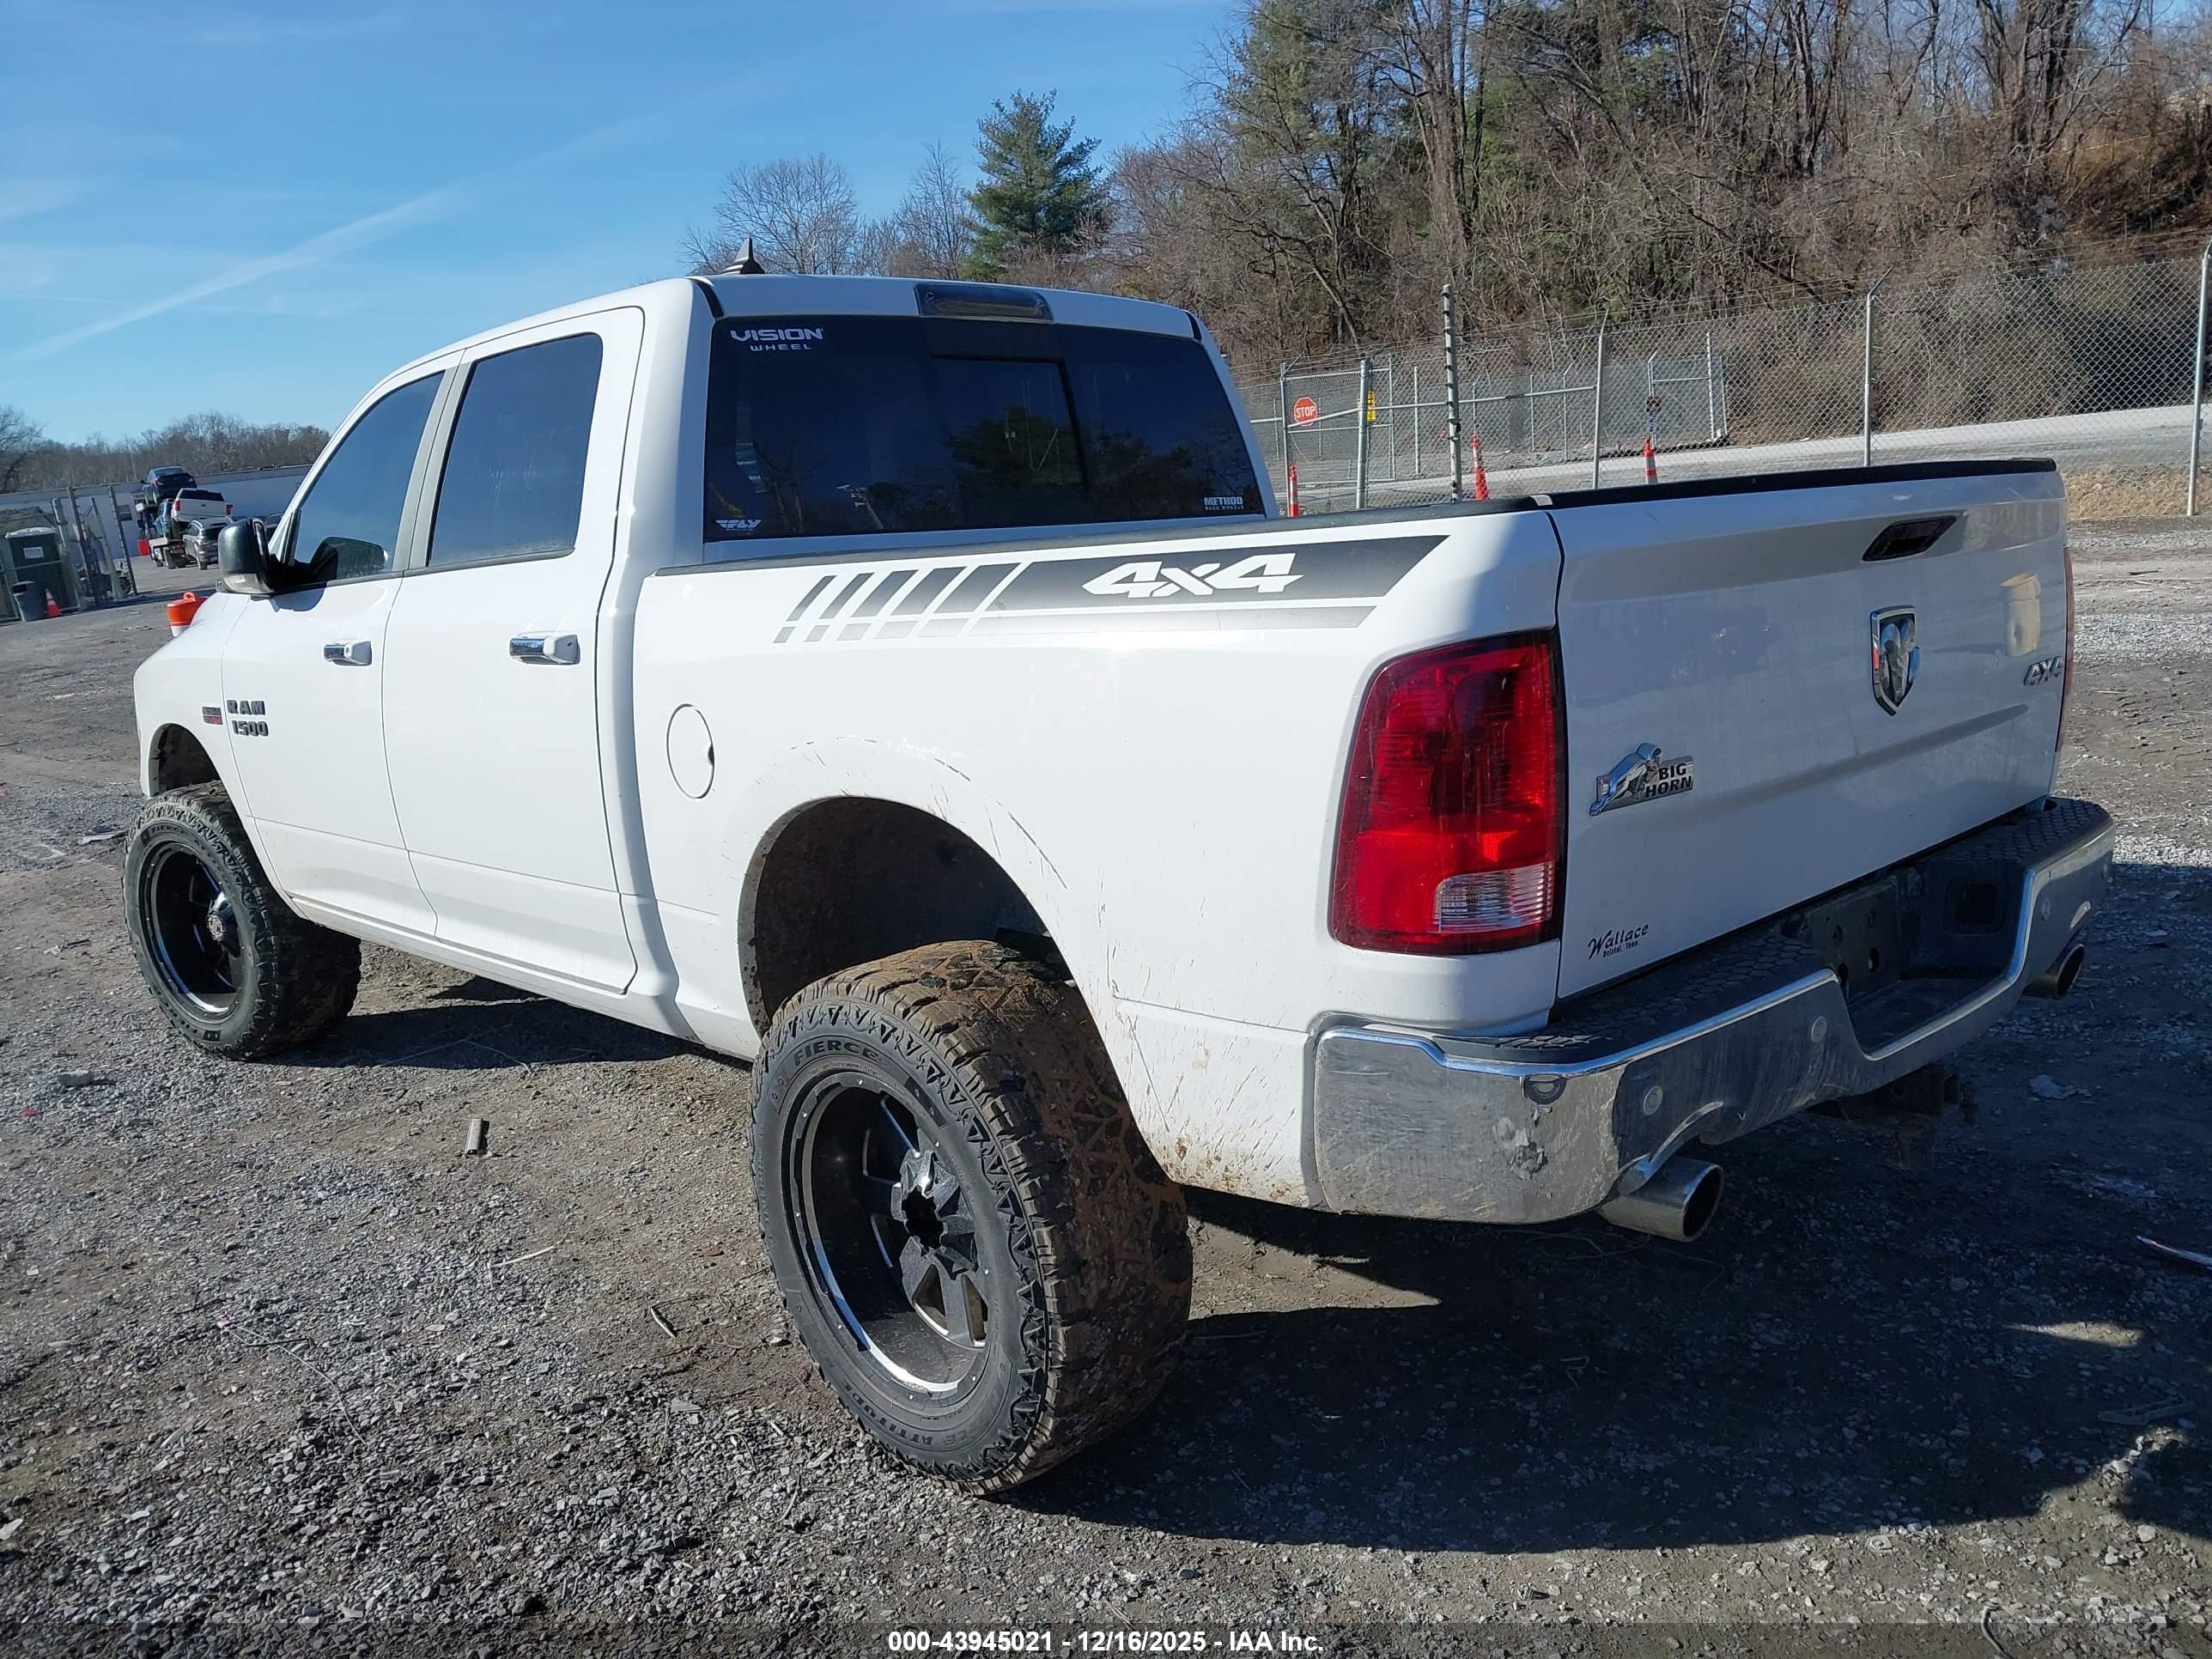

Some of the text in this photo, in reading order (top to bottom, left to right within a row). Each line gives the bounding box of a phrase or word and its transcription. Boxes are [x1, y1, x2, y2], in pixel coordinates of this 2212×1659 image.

[730, 328, 823, 342] VISION
[1295, 405, 1316, 419] STOP
[1203, 496, 1243, 506] METHOD
[226, 699, 266, 716] RAM
[231, 720, 270, 737] 1500
[1658, 763, 1687, 781] BIG
[1644, 775, 1692, 799] HORN
[1587, 924, 1650, 960] Wallace
[793, 1040, 884, 1066] FIERCE
